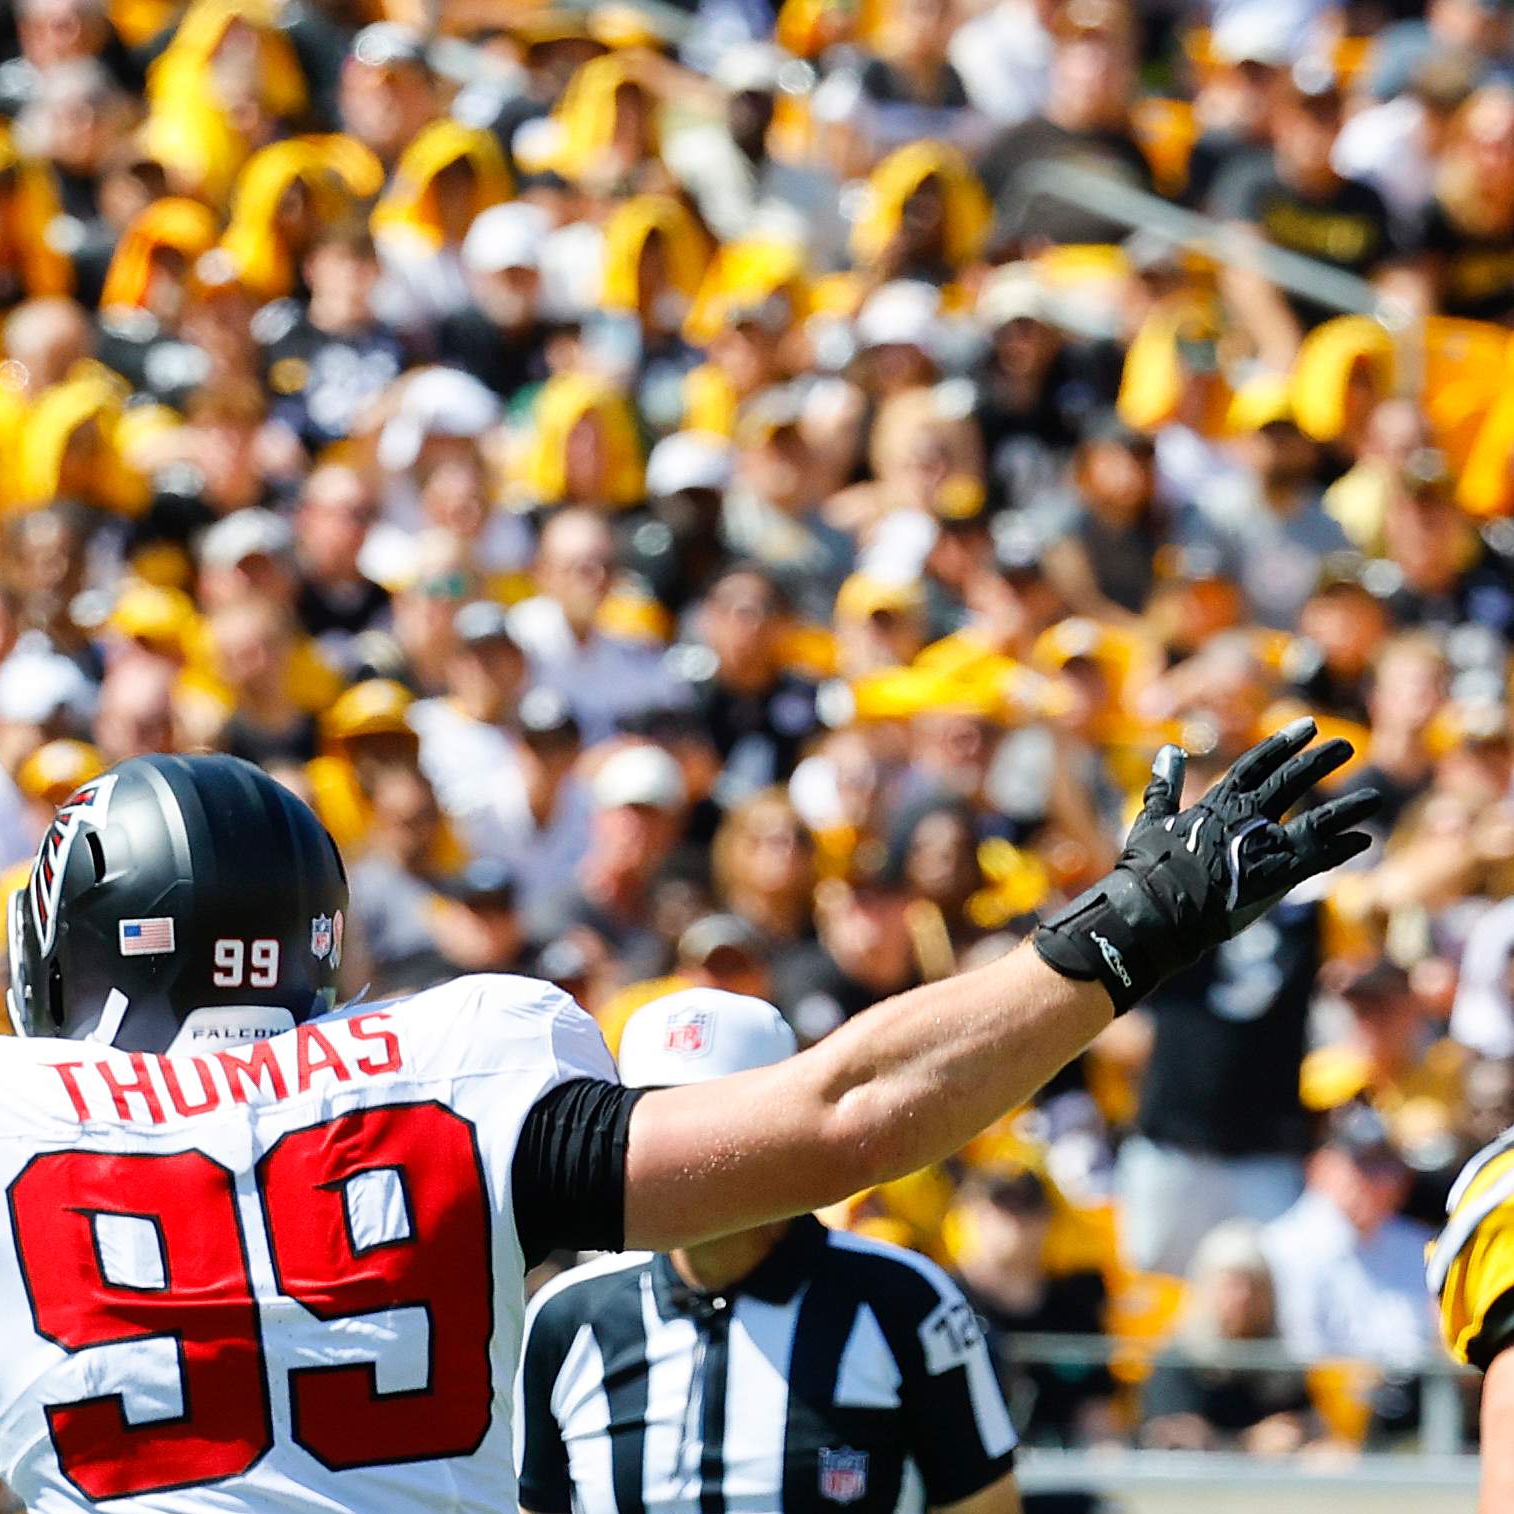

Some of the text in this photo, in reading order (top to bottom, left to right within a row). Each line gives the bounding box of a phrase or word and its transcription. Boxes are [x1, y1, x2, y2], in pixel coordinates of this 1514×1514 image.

[212, 937, 280, 988] 99
[40, 1012, 403, 1126] THOMAS
[192, 1027, 289, 1041] FALCON
[6, 1099, 495, 1501] 99
